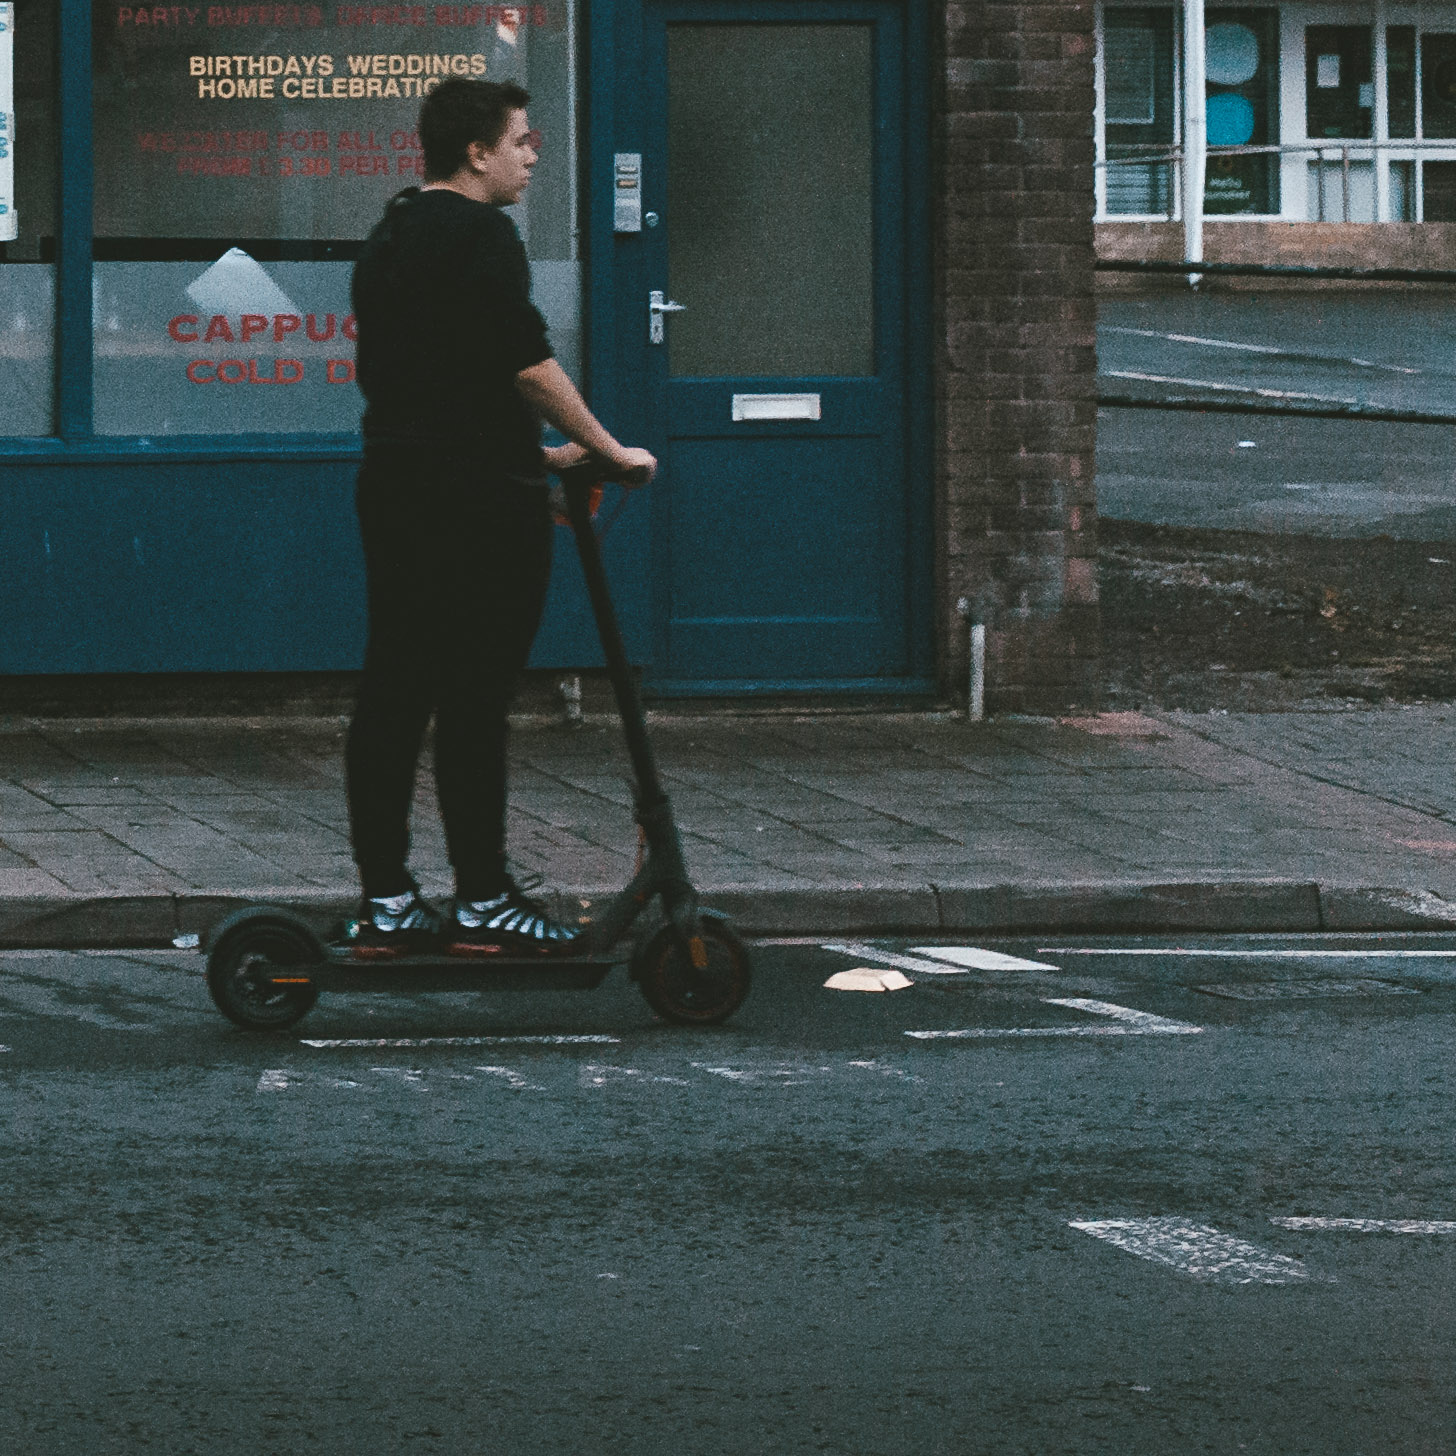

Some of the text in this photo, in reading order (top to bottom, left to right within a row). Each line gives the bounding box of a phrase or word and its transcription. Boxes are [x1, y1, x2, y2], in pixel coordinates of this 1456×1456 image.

[117, 4, 548, 28] PARTY BUFFETS OFFICE BUFFETS
[189, 54, 487, 77] BIRTHDAYS WEDDINGS
[198, 77, 476, 99] HOME CELEBRATI
[276, 130, 329, 152] FOR
[337, 130, 386, 152] ALL
[339, 156, 392, 177] PER
[167, 313, 359, 343] CAPPUC
[186, 358, 305, 385] COLD
